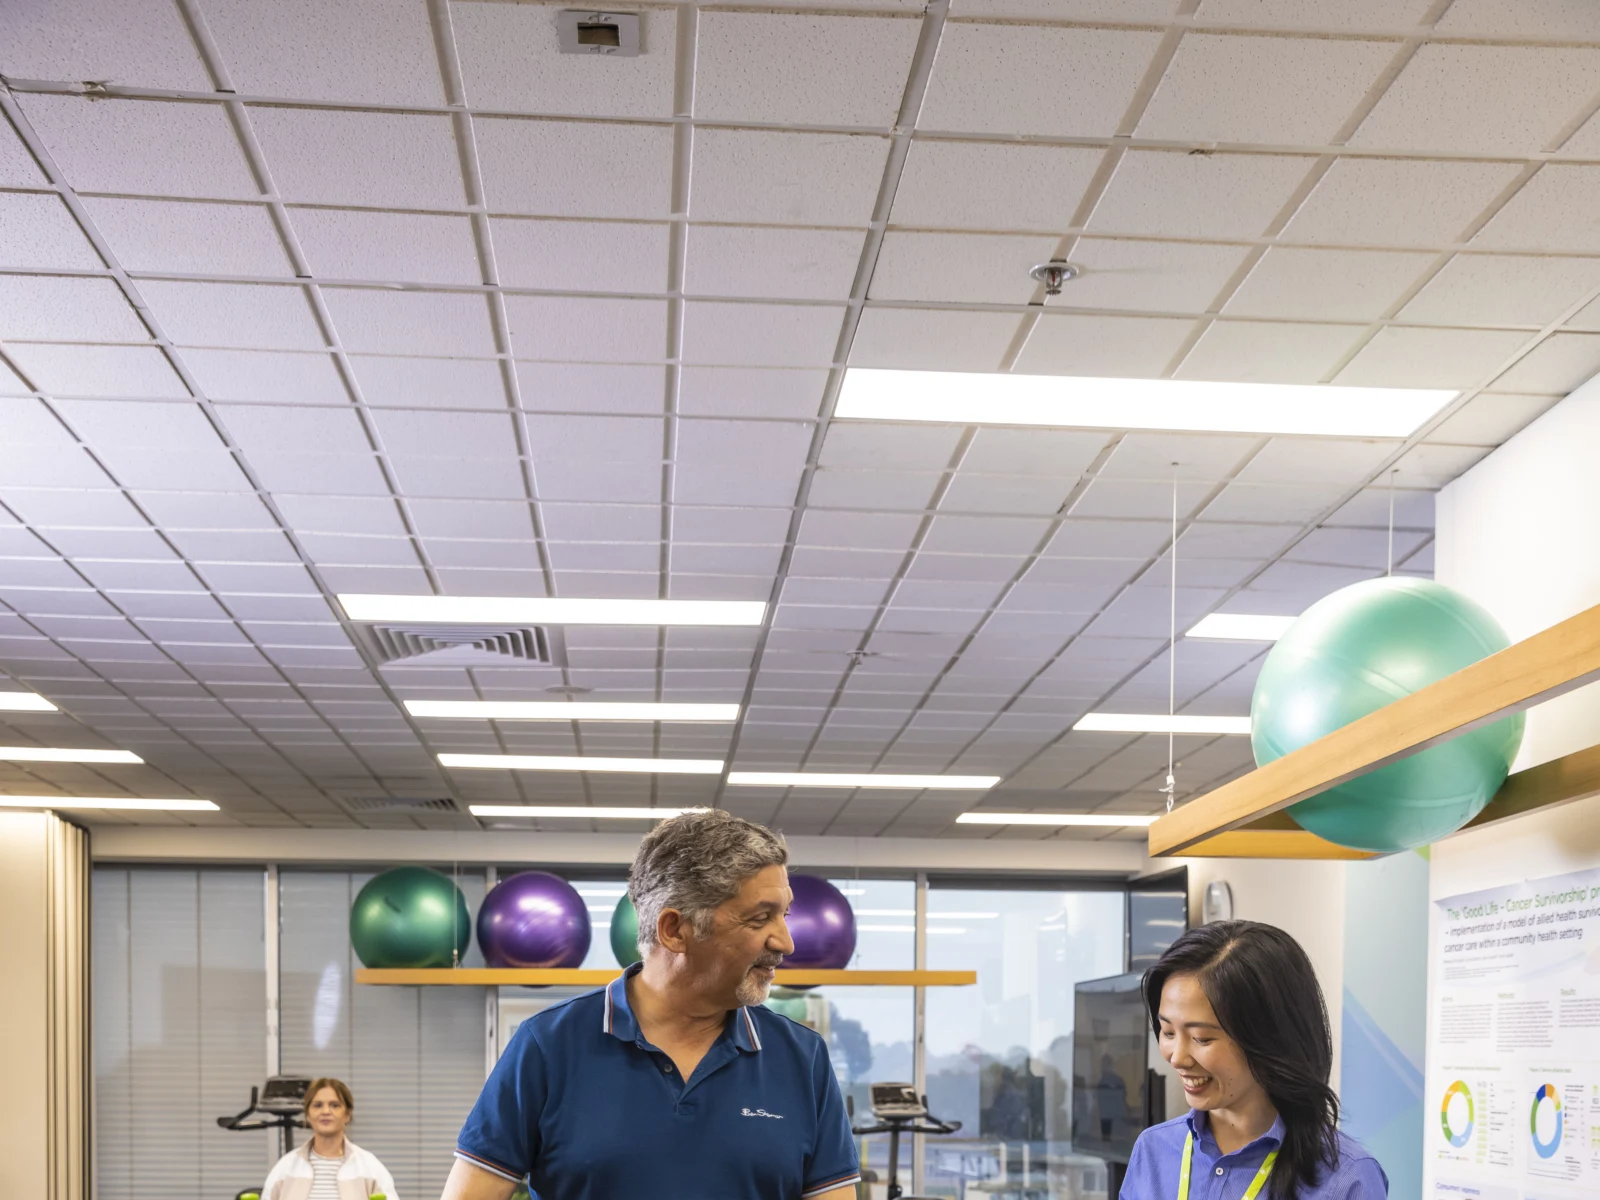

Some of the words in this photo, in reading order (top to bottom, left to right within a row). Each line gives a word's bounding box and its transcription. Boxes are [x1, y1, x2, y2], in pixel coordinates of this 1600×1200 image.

[1447, 908, 1460, 921] The
[1484, 901, 1499, 916] Life
[1506, 898, 1532, 913] Cancer
[1496, 919, 1502, 931] of
[1507, 915, 1526, 929] model
[1528, 914, 1535, 926] of
[1536, 911, 1555, 926] allied
[1556, 908, 1577, 922] health
[1444, 942, 1464, 953] cancer
[1465, 941, 1477, 951] care
[1479, 937, 1496, 949] within
[1501, 933, 1536, 947] community
[1537, 929, 1558, 942] health
[1559, 927, 1583, 940] setting
